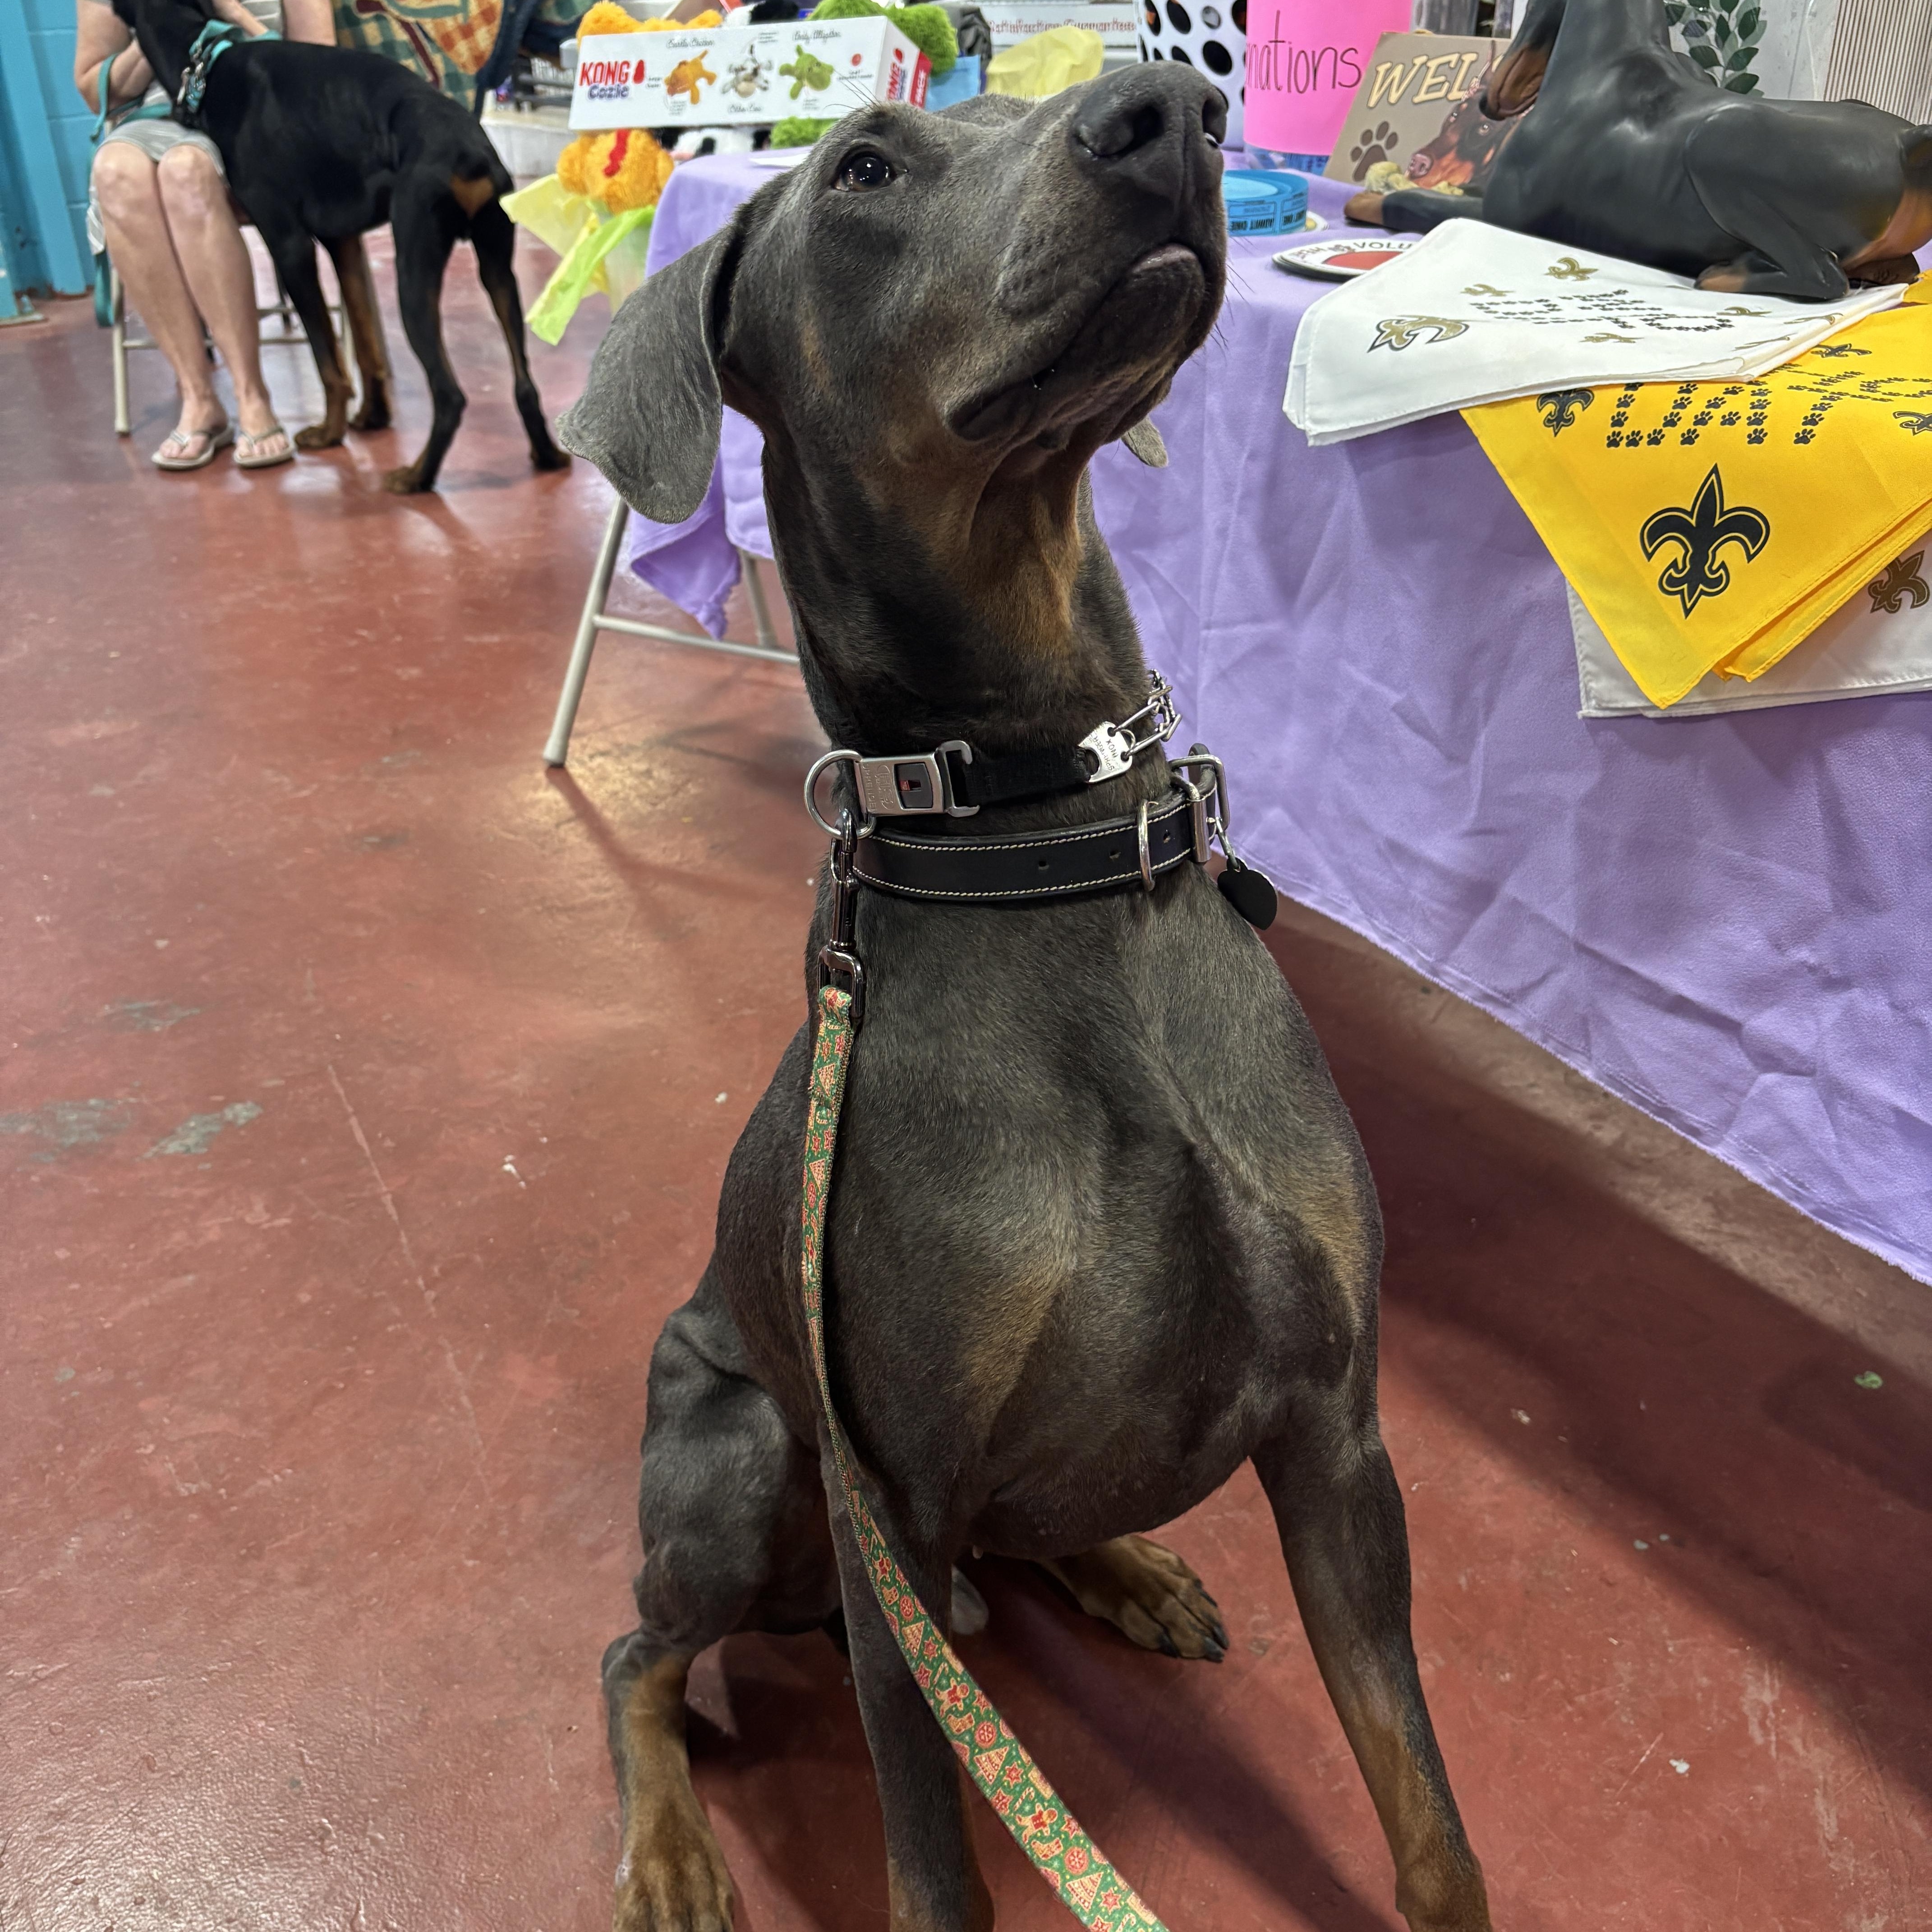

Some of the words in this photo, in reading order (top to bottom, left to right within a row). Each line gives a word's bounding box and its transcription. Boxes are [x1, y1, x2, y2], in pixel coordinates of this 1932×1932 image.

[579, 60, 630, 86] KONG
[1247, 10, 1362, 93] nations
[1367, 52, 1479, 109] WEL
